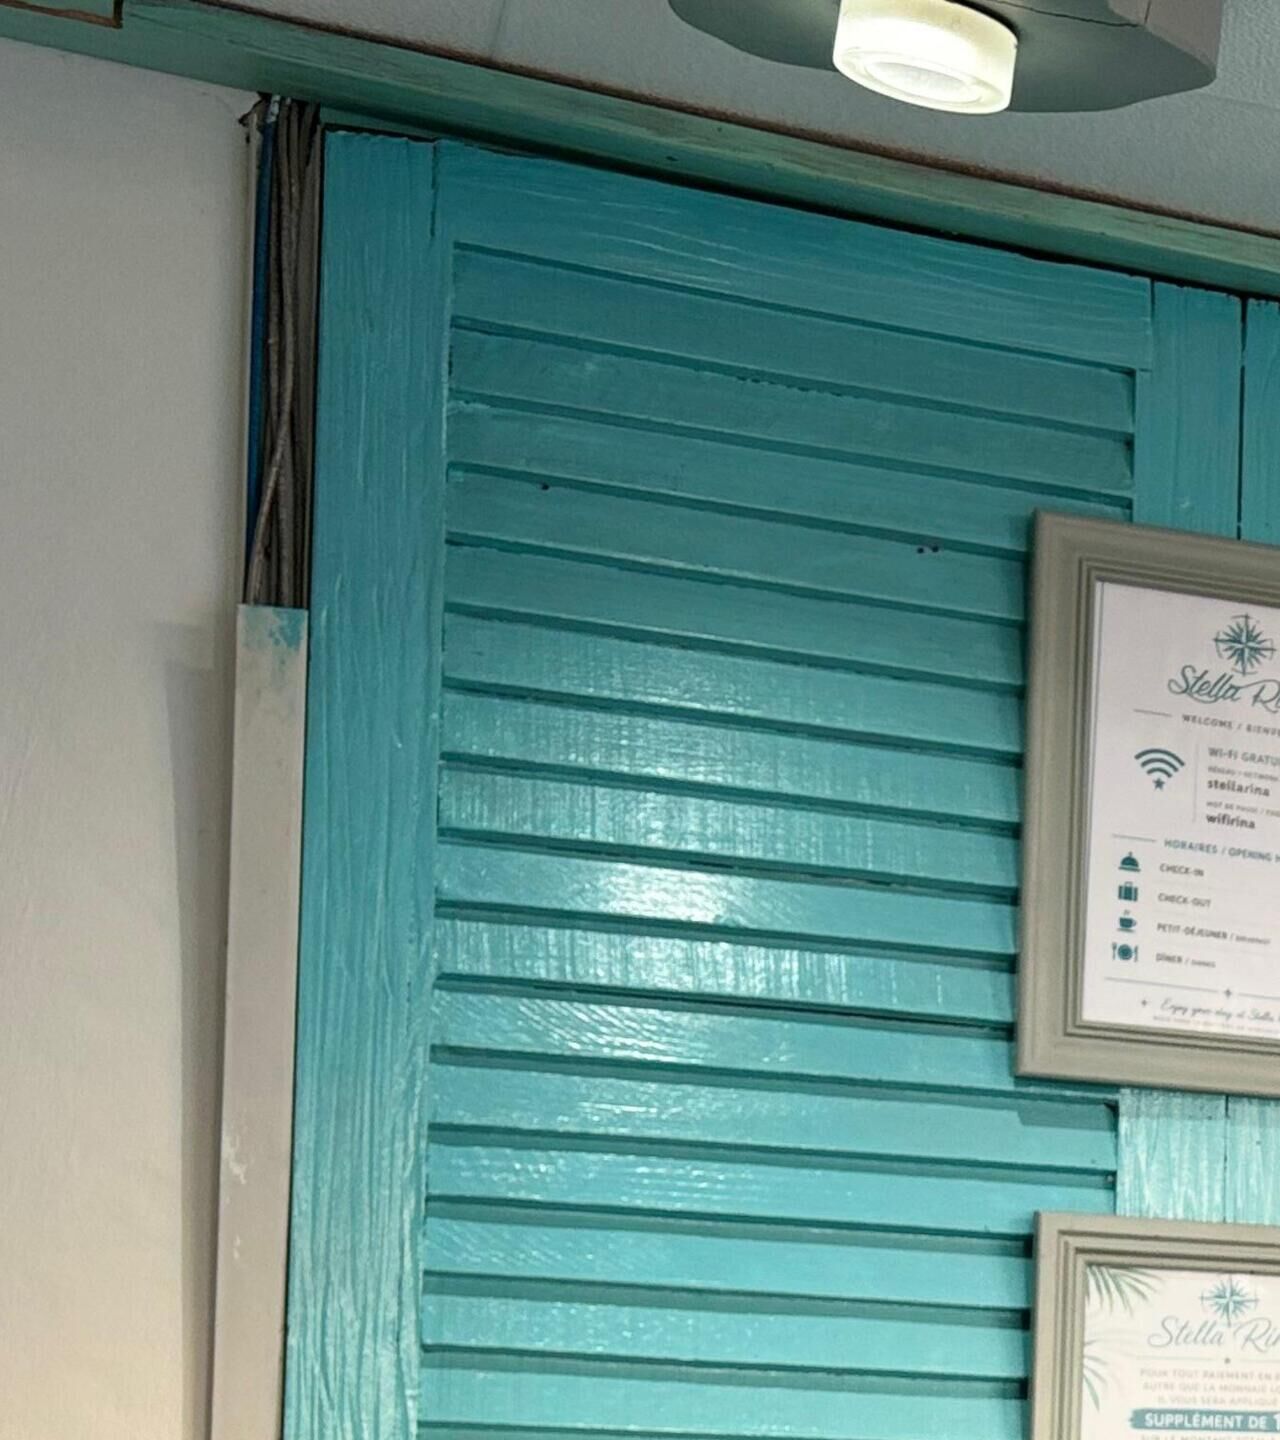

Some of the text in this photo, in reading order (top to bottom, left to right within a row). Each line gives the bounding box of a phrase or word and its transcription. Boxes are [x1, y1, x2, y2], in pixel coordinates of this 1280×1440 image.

[1168, 665, 1241, 704] Stella
[1182, 714, 1233, 730] WELCOME
[1207, 779, 1270, 796] stellarina
[1206, 812, 1255, 829] wifirina
[1164, 839, 1218, 855] HORAIRES
[1228, 848, 1272, 862] OPENING
[1159, 863, 1205, 877] CHECK-IN
[1147, 1315, 1225, 1349] Stella
[1145, 1411, 1244, 1430] SUPPLÉMENT
[1248, 1416, 1268, 1429] DE
